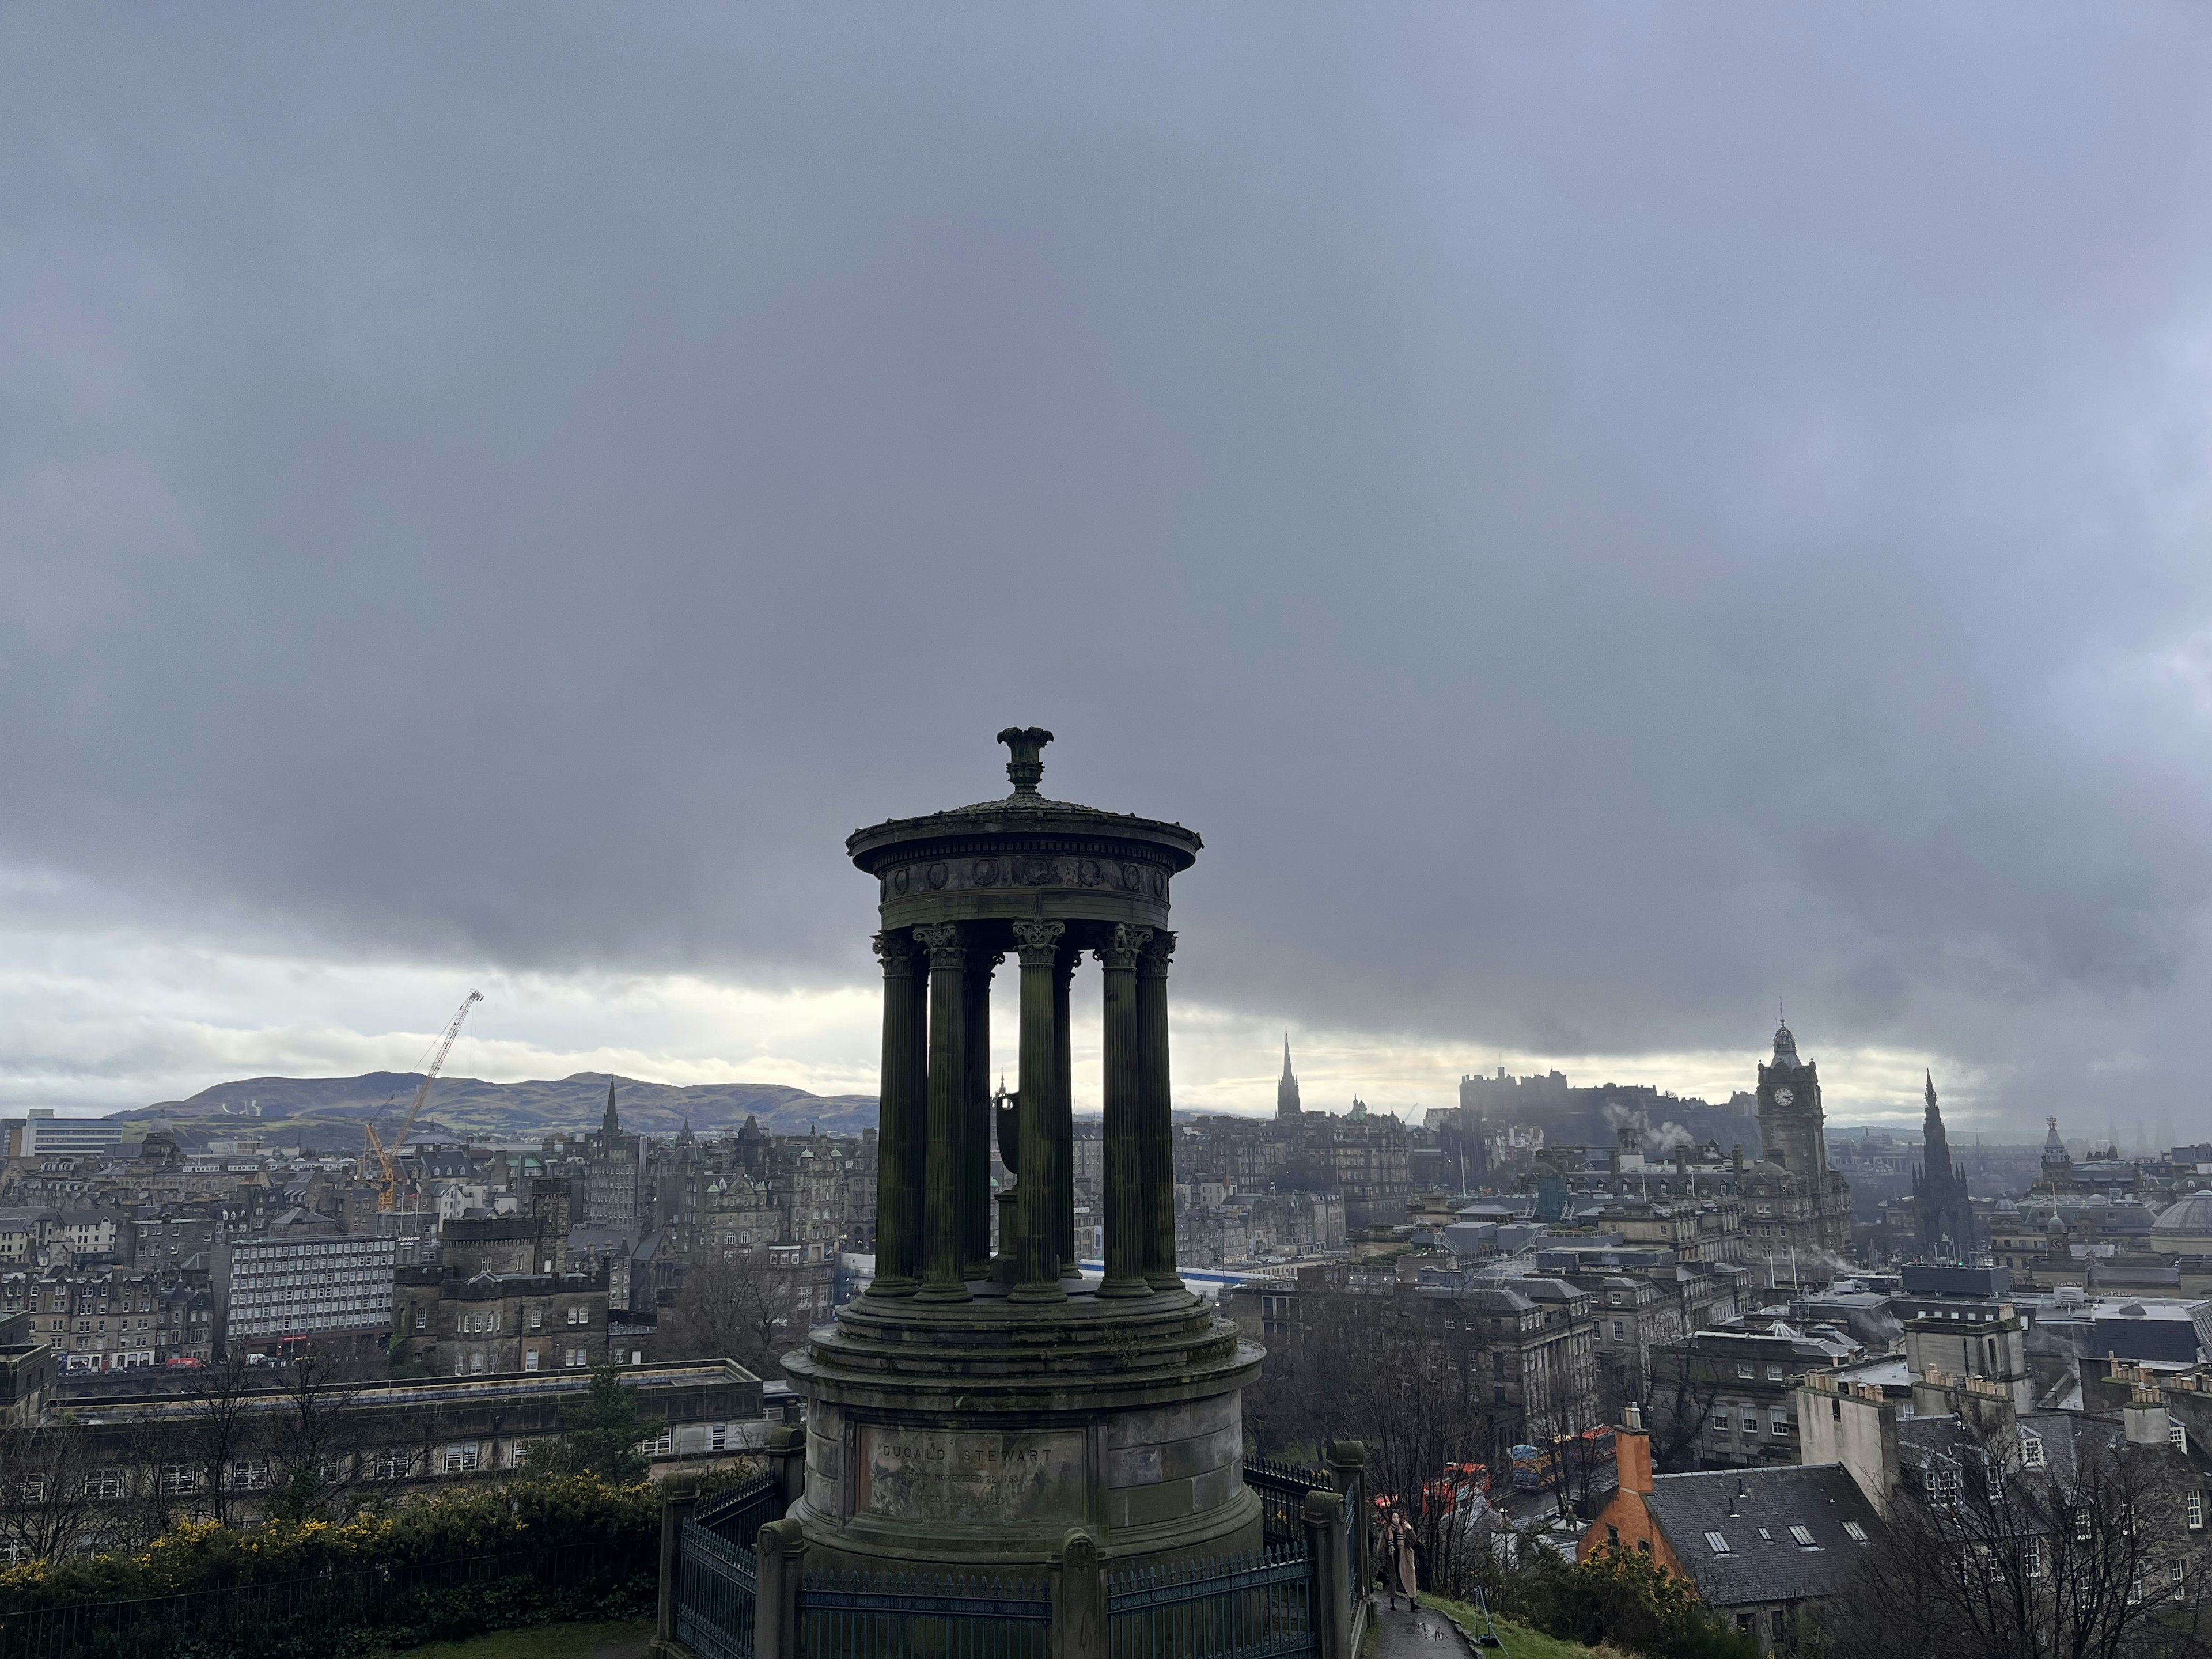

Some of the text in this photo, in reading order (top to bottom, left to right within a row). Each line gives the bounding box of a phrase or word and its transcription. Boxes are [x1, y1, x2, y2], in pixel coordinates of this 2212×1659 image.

[964, 1449, 1051, 1462] STEWART
[935, 1474, 982, 1483] NOVEMBER
[986, 1475, 997, 1483] 22
[1001, 1475, 1019, 1483] 1753
